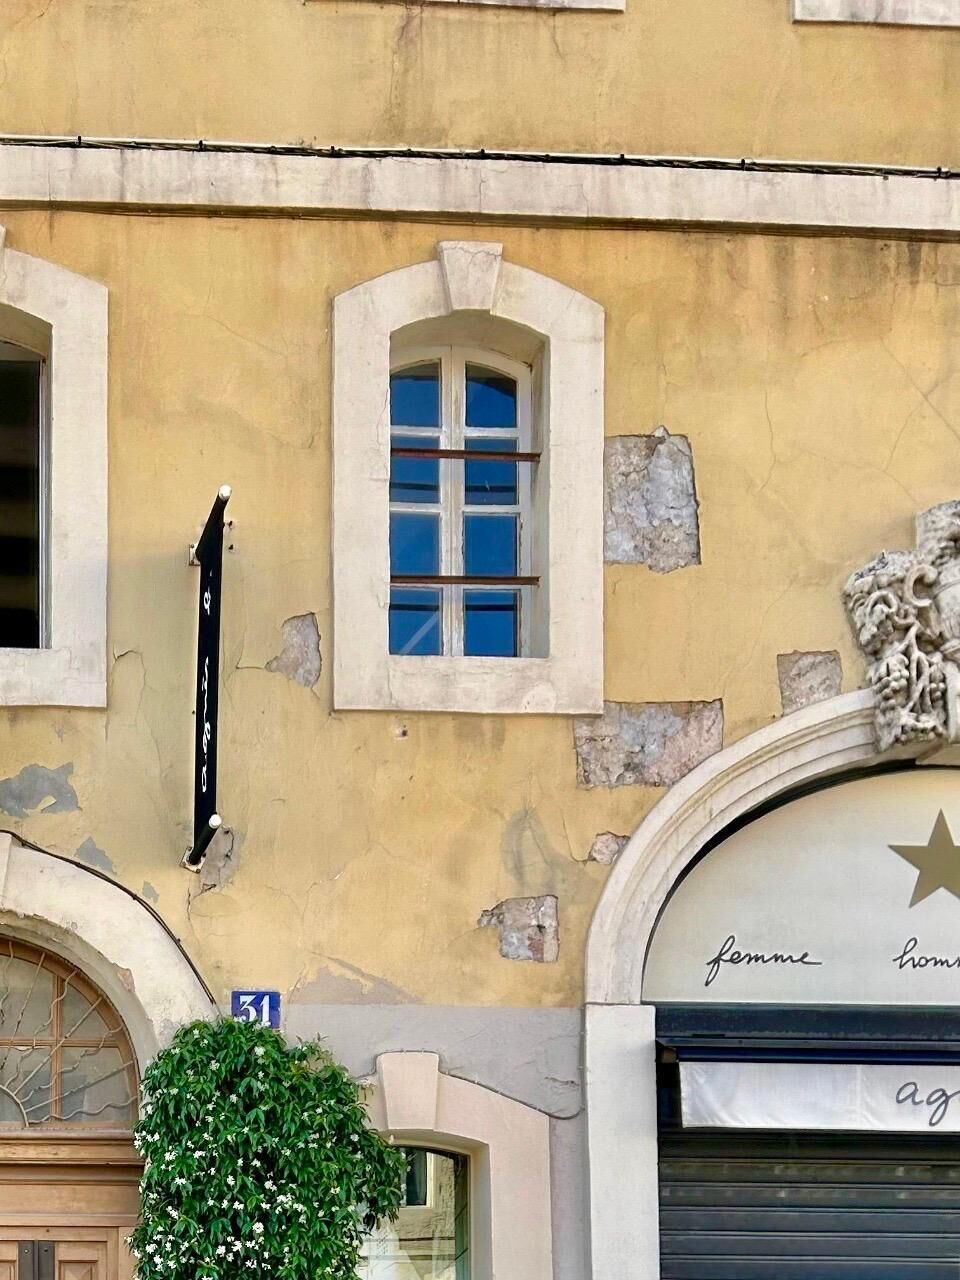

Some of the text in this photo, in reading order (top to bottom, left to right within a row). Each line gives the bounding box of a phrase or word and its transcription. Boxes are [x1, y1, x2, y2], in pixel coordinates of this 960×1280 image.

[705, 935, 822, 987] femme
[893, 937, 960, 969] hom
[239, 994, 270, 1024] 31
